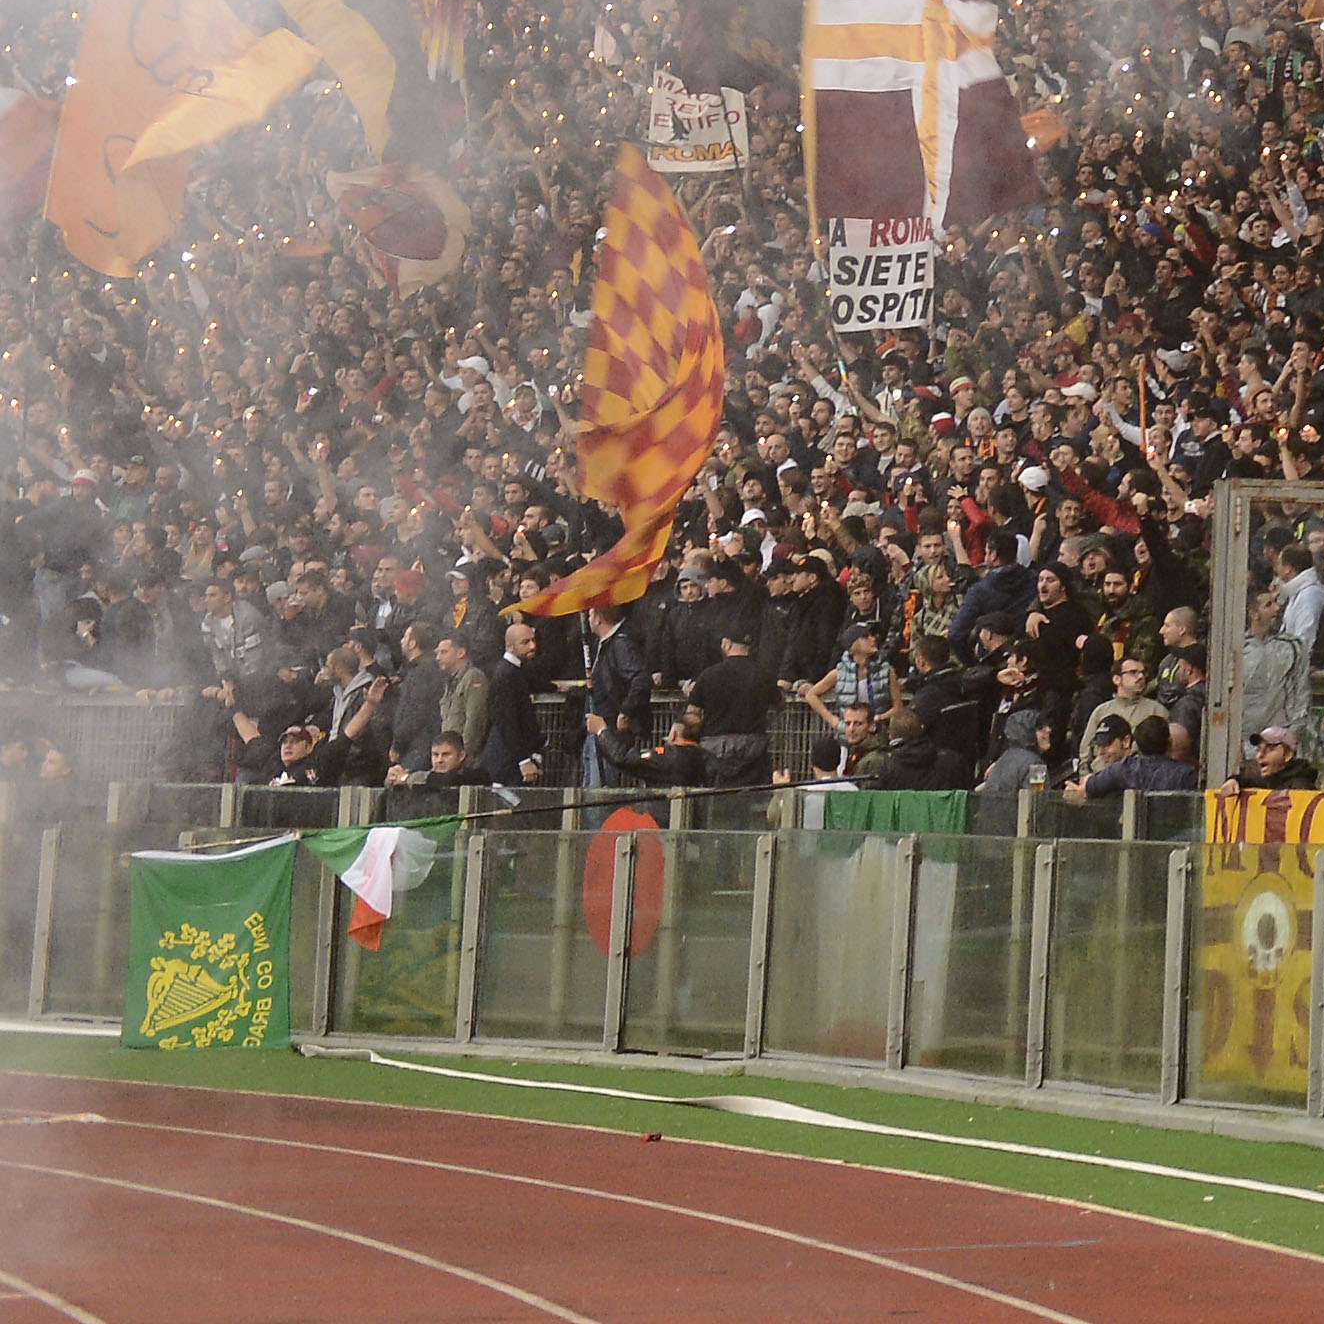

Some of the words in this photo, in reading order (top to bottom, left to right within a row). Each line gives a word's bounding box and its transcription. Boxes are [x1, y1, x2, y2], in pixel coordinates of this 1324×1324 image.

[650, 141, 744, 162] ROMA
[830, 217, 847, 248] A
[869, 217, 935, 248] ROMA
[833, 251, 929, 287] SIETE
[832, 288, 934, 325] OSPITI
